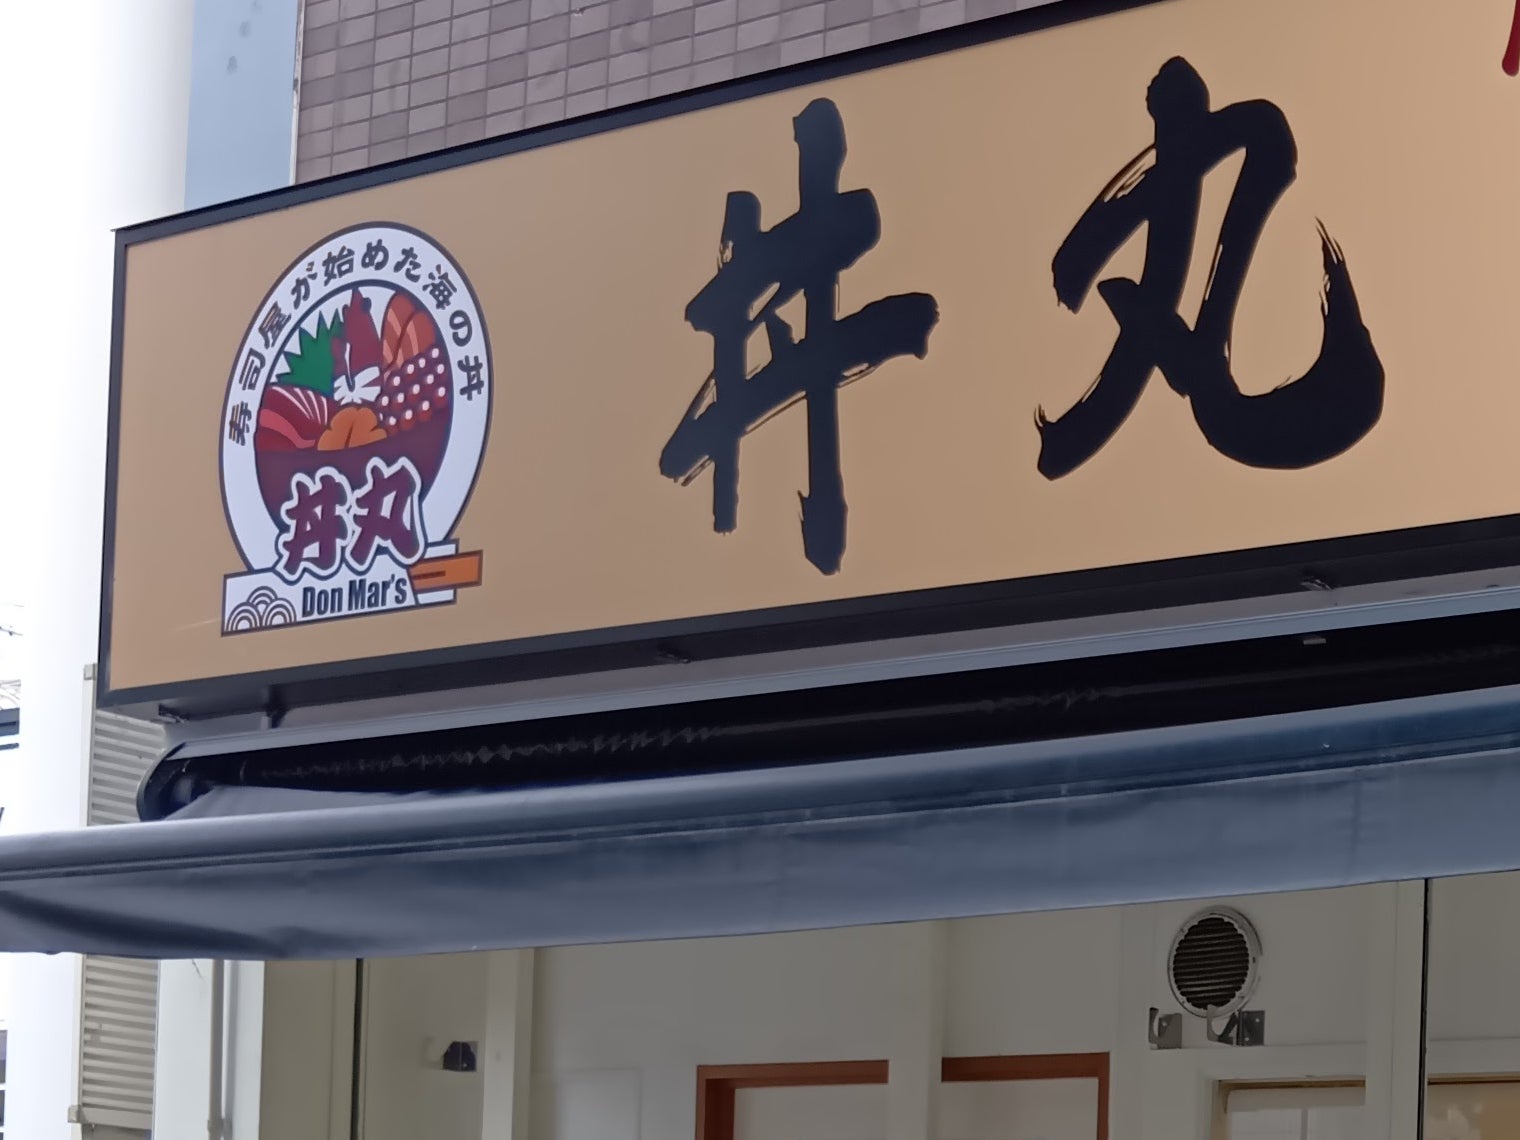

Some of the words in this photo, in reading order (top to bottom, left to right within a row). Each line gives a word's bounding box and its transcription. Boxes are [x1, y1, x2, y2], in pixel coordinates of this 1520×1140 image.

[229, 239, 487, 446] 寿司屋が始めた海の丼
[659, 55, 1385, 576] 丼丸
[283, 467, 420, 572] 丼丸
[302, 586, 342, 618] Don
[349, 576, 407, 611] Mar's
